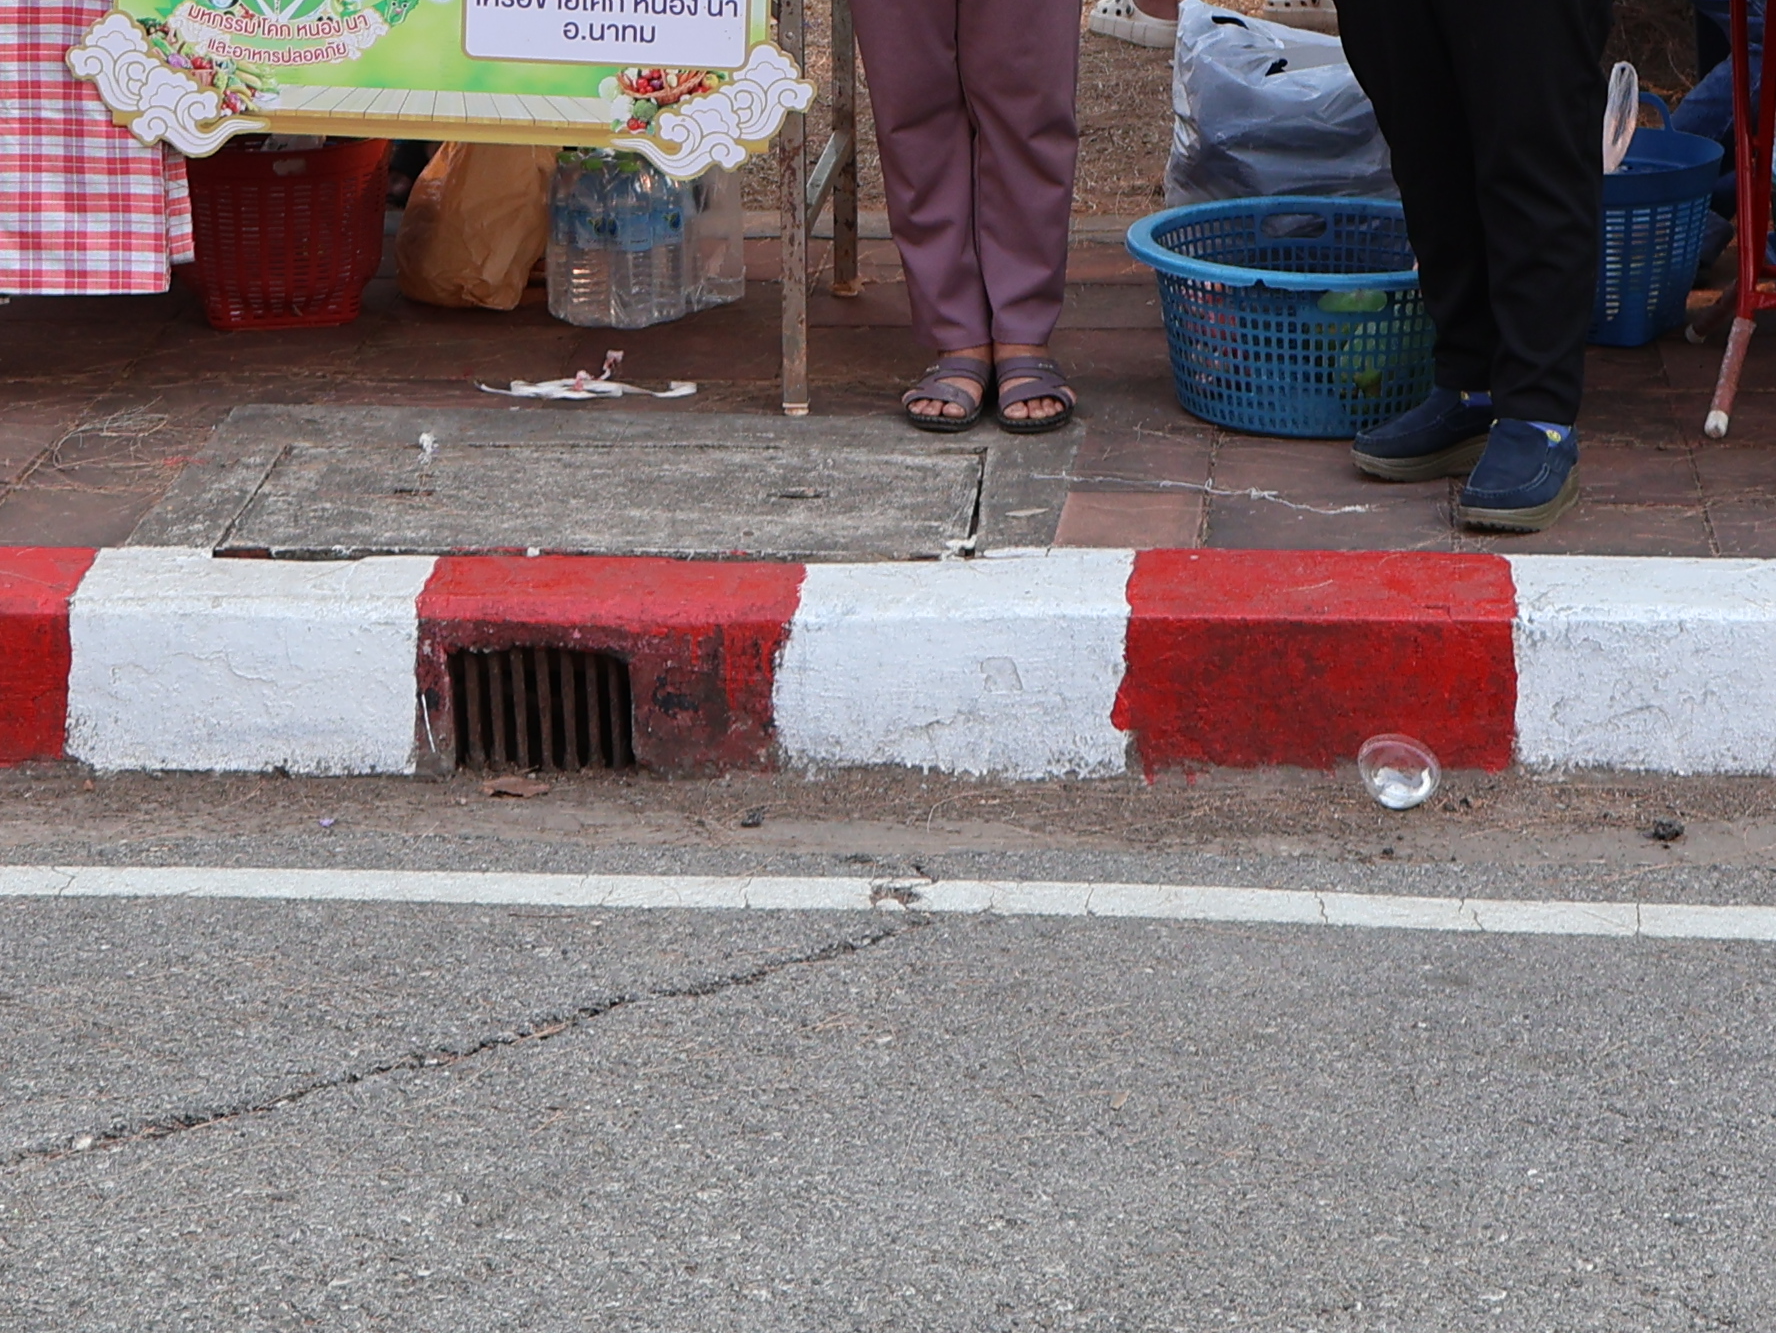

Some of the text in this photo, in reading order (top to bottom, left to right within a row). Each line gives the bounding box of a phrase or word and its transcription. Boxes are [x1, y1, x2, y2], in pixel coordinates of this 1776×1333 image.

[188, 5, 370, 38] มหกรรม โคก หนอง นา
[562, 21, 656, 44] อ.นาทม
[207, 37, 348, 64] และอาหารปลอดภัย
